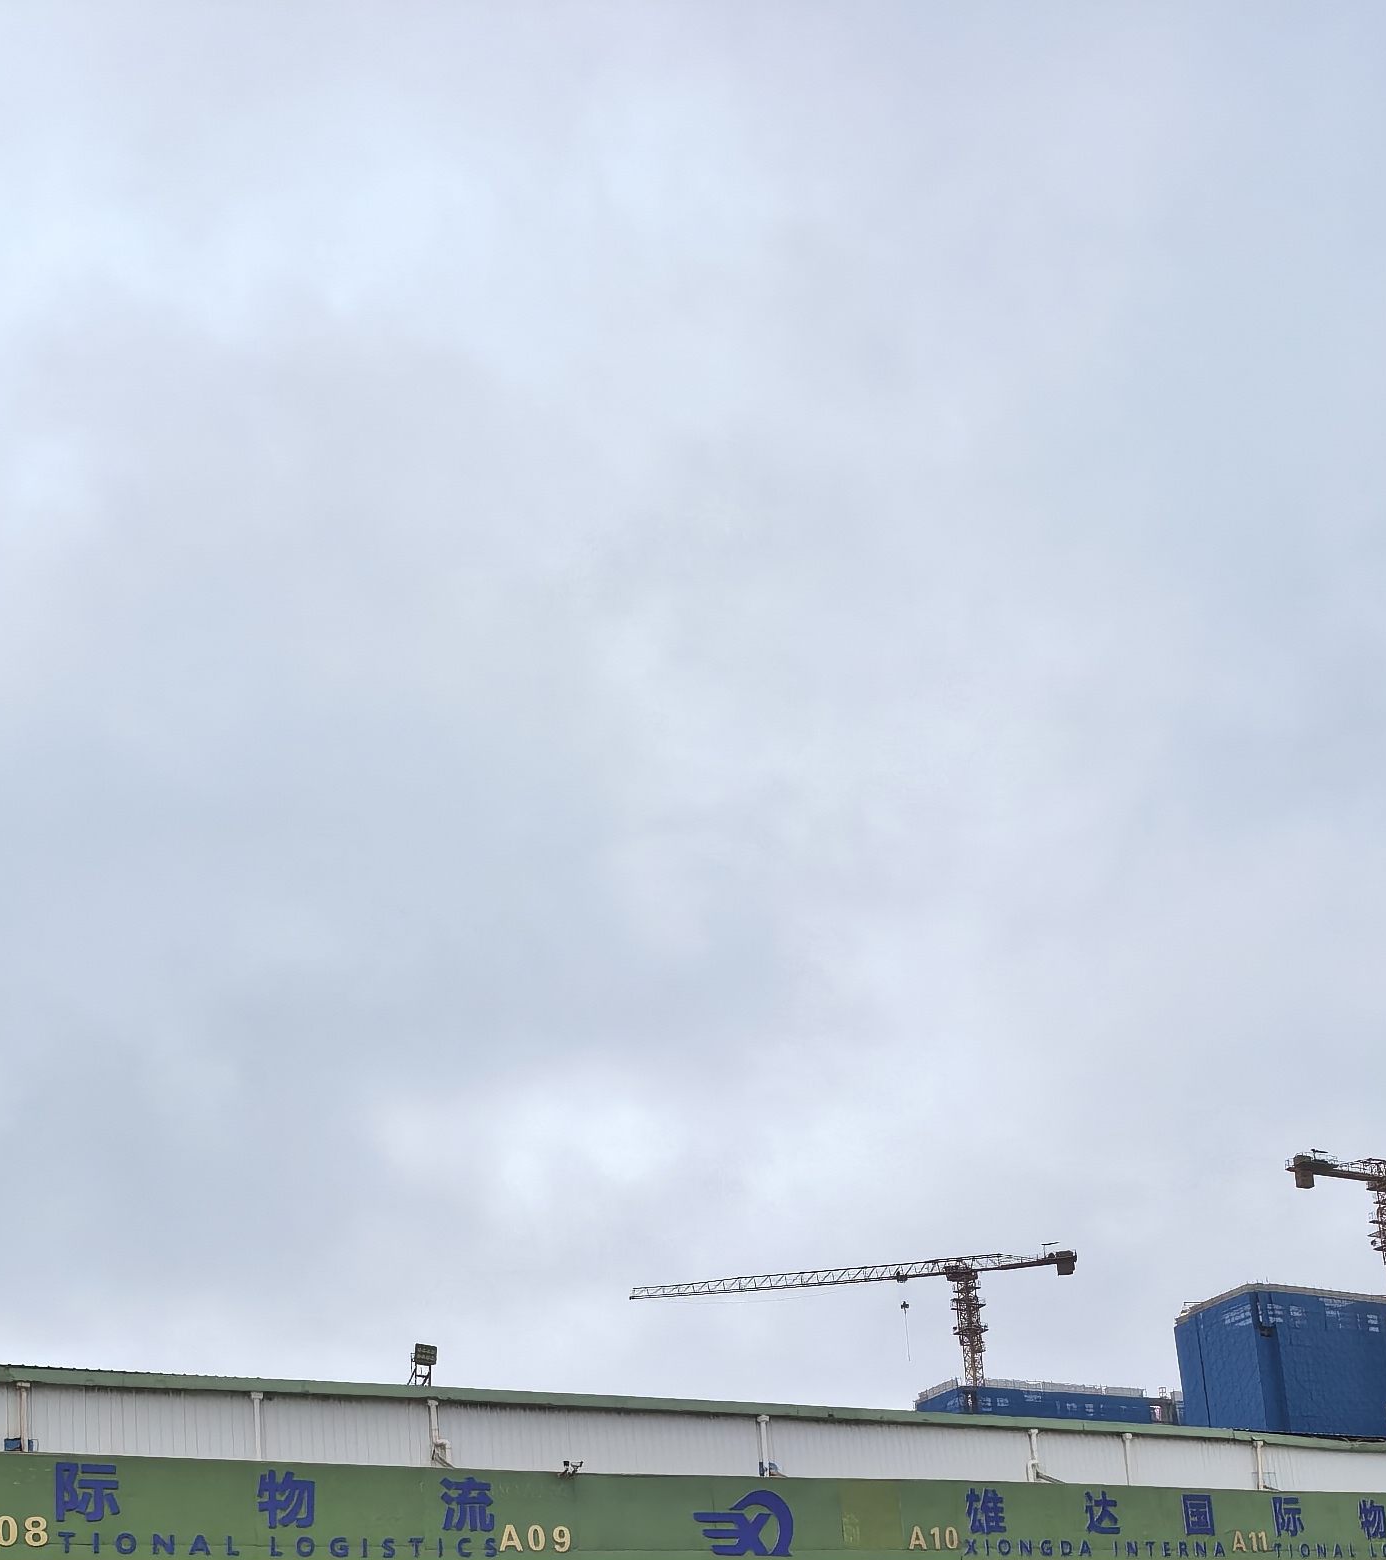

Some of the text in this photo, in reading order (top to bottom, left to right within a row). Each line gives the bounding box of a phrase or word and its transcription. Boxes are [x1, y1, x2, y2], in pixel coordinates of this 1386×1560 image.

[269, 1533, 499, 1558] LOGISTICS
[499, 1523, 571, 1553] A09
[909, 1525, 959, 1550] A10
[964, 1538, 1093, 1557] XIONGDA
[1232, 1530, 1269, 1553] A11
